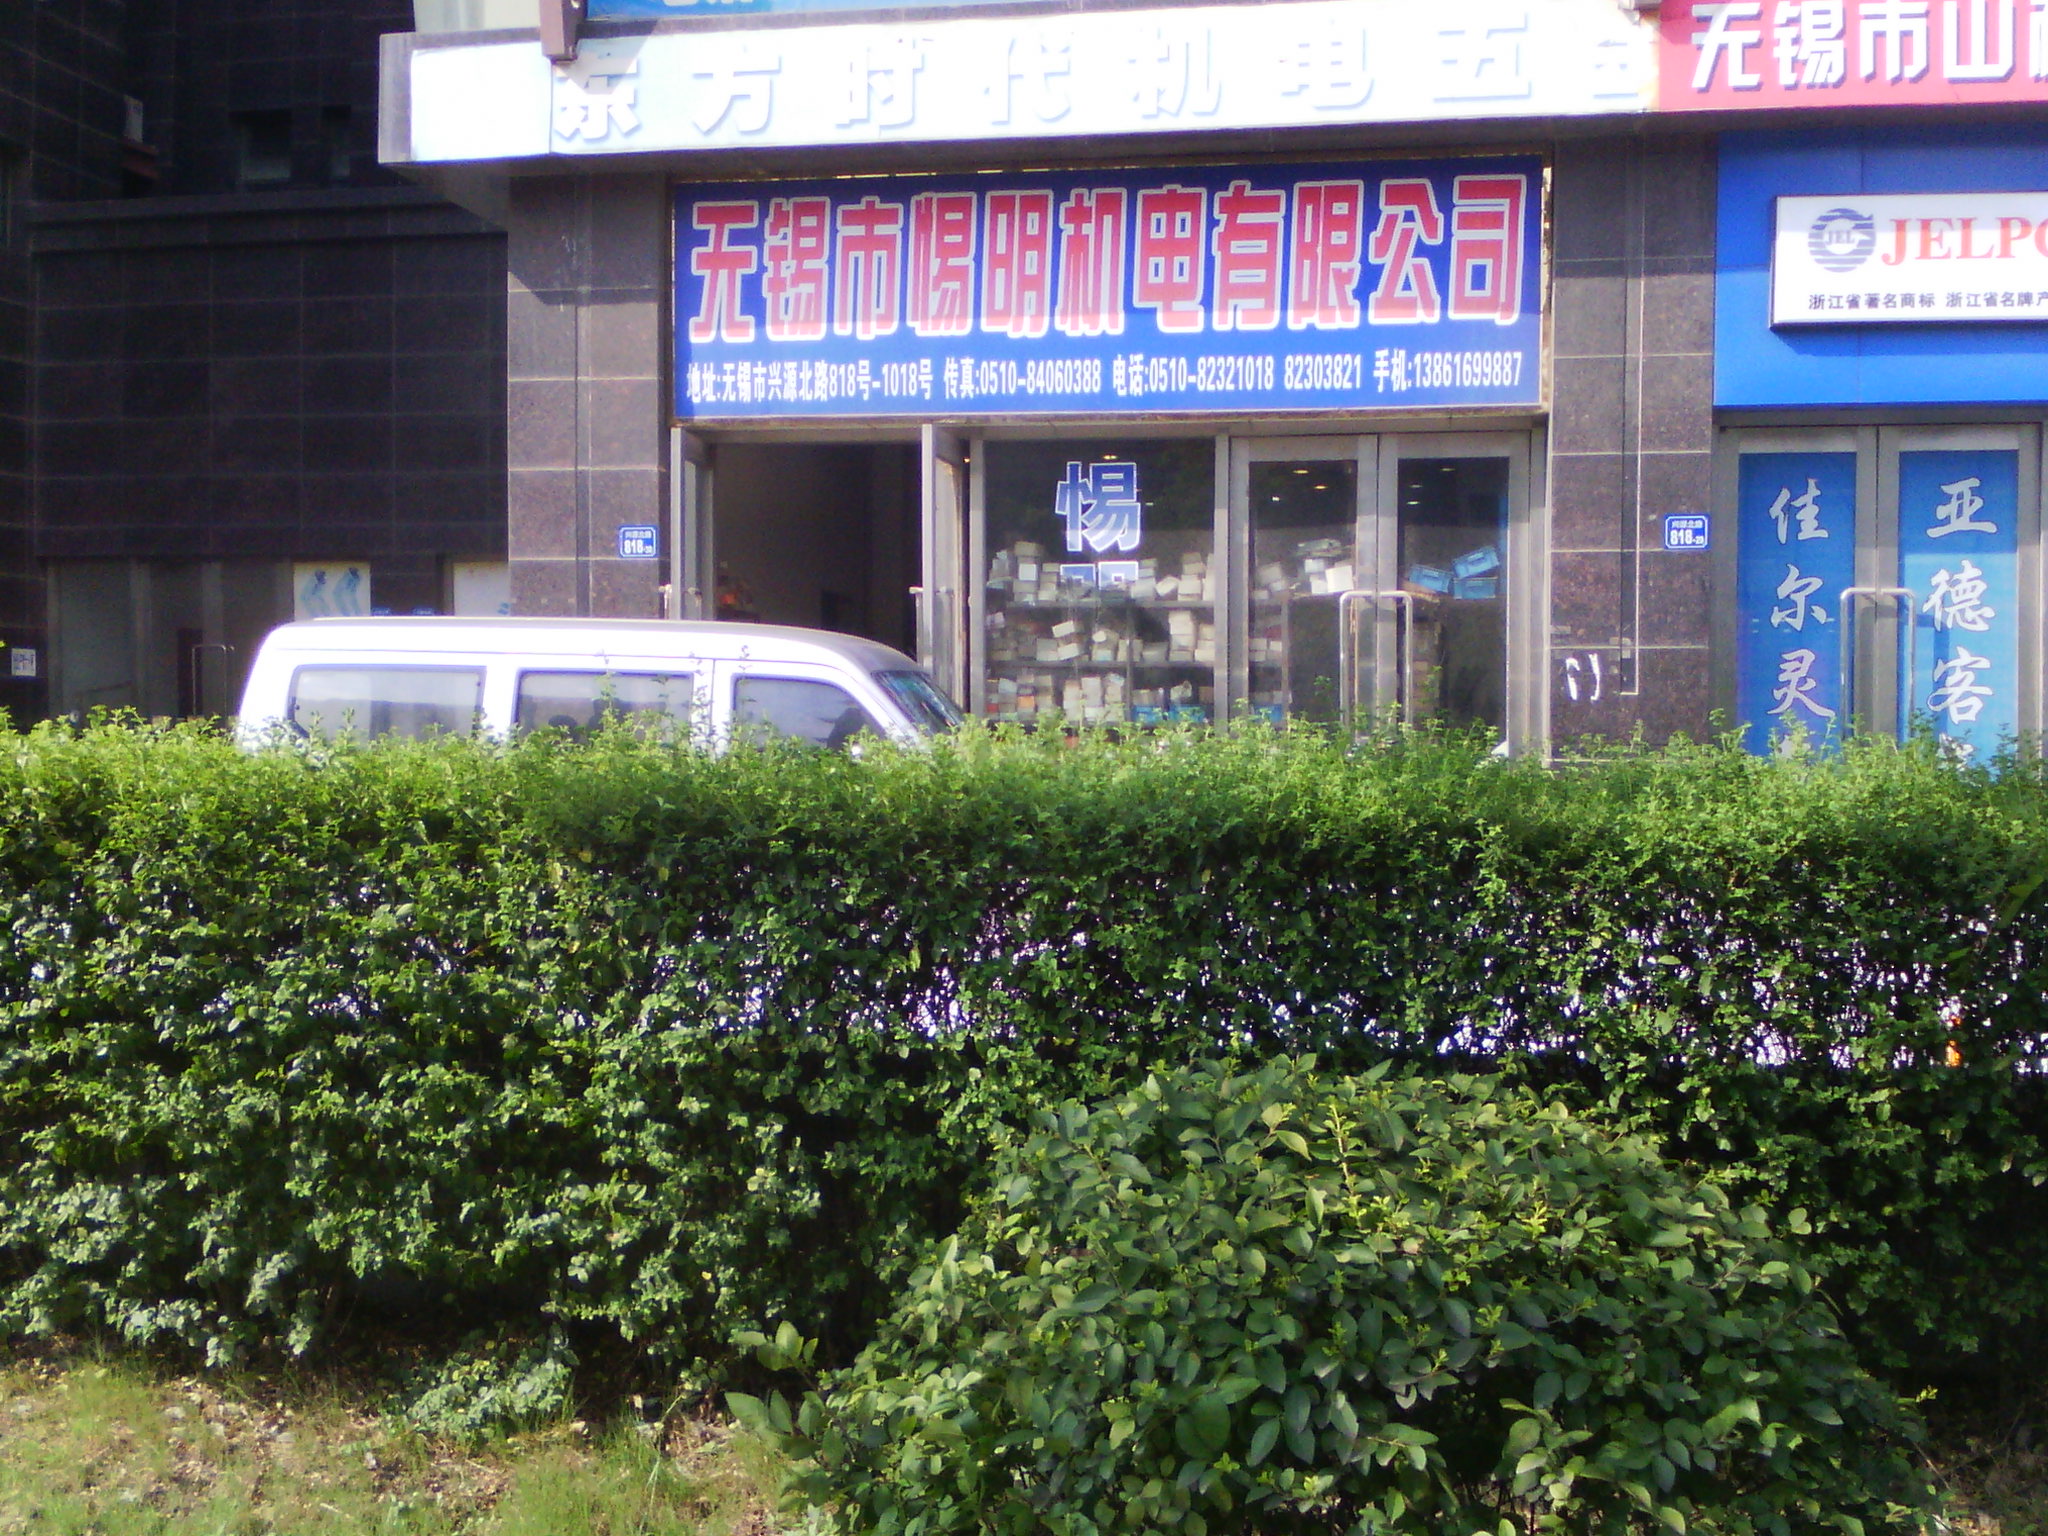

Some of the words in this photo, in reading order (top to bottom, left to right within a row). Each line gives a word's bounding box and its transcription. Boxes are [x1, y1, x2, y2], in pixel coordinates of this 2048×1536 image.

[1691, 0, 2048, 92] 无锡市山
[1809, 292, 1936, 310] 浙江省著名商标
[944, 356, 1102, 399] 传真:0510-84060388
[1113, 353, 1274, 396] 电话:0510-82321018
[1284, 354, 1362, 390] 82303821
[1373, 348, 1523, 392] 手机:13861699887
[1768, 478, 1836, 758] 佳尔灵
